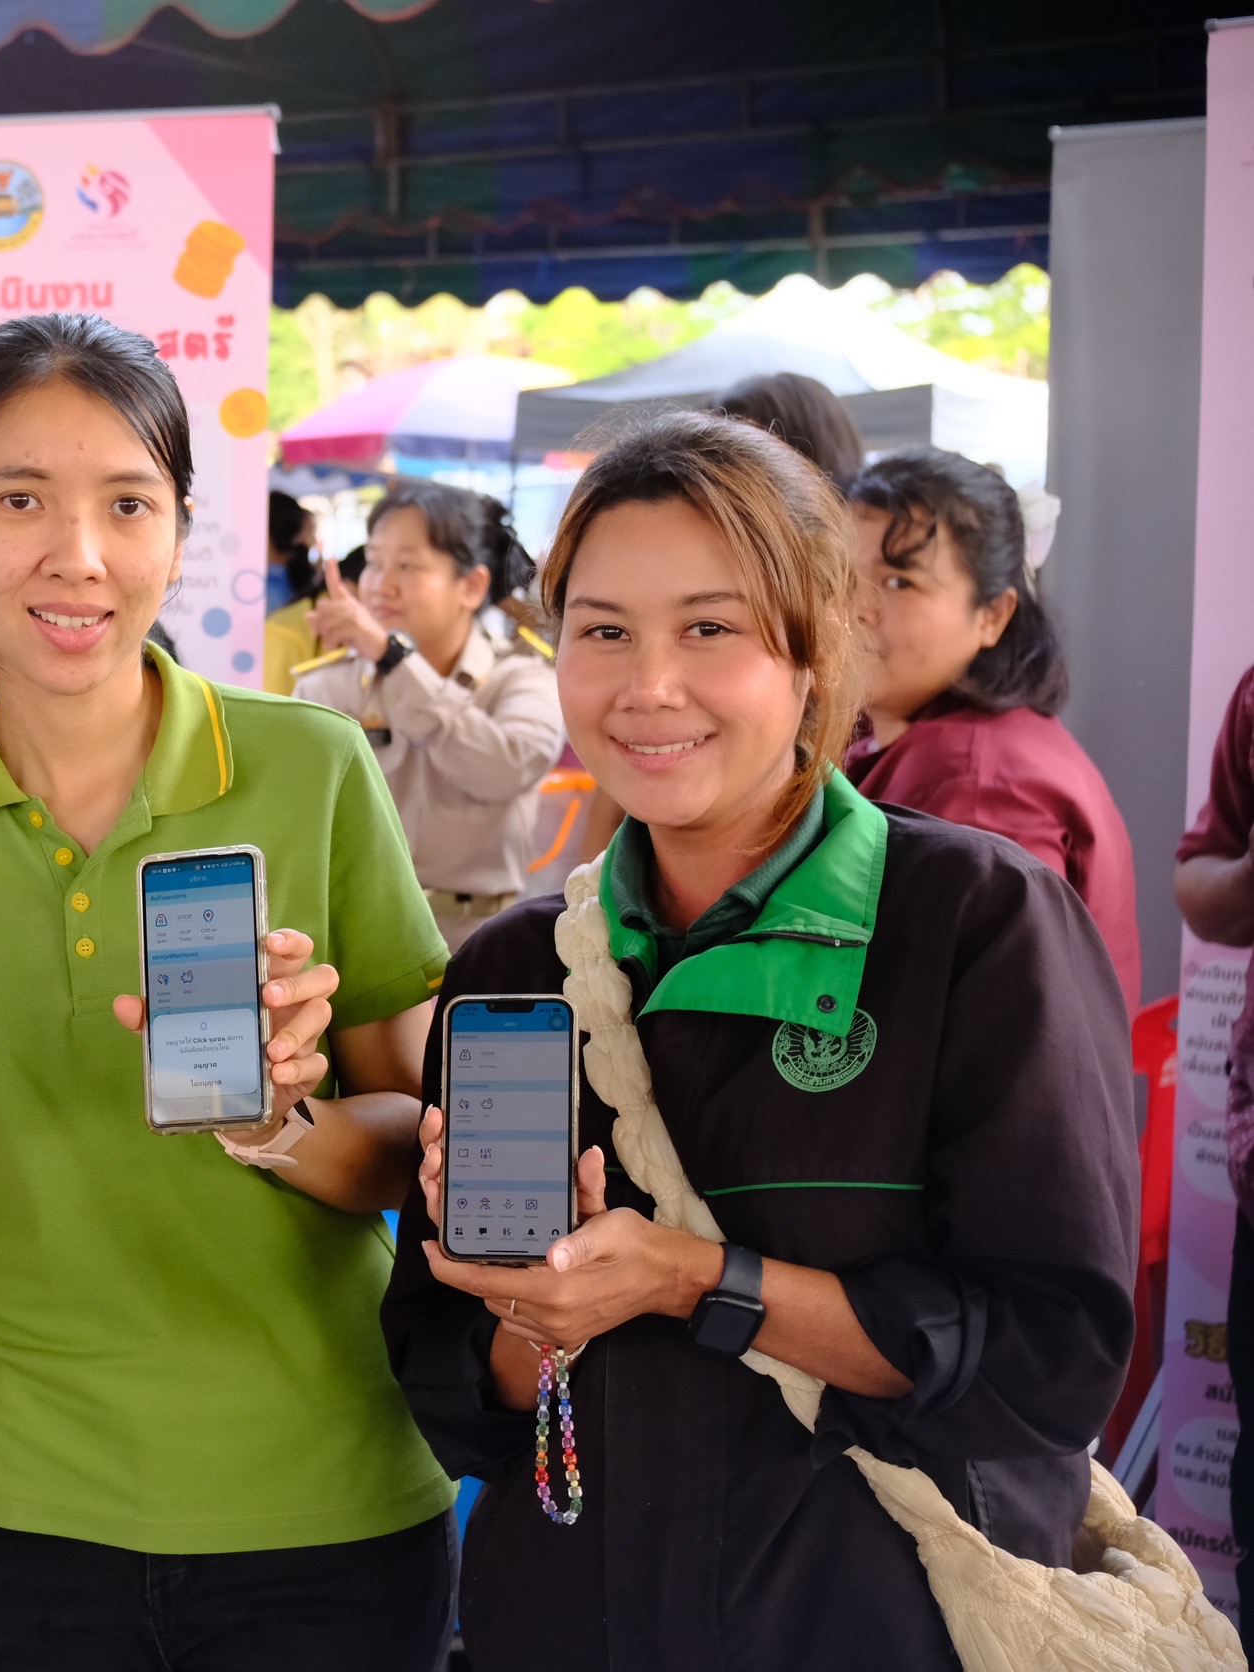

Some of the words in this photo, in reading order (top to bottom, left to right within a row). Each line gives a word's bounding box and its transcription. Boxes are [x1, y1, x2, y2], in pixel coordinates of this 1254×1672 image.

[189, 875, 208, 883] บริการ
[1184, 960, 1245, 985] เป็นเงินทุ
[193, 1062, 218, 1070] อนุญาต
[190, 1078, 222, 1088] ไม่อนุญาต
[1173, 1464, 1233, 1487] และสำนั
